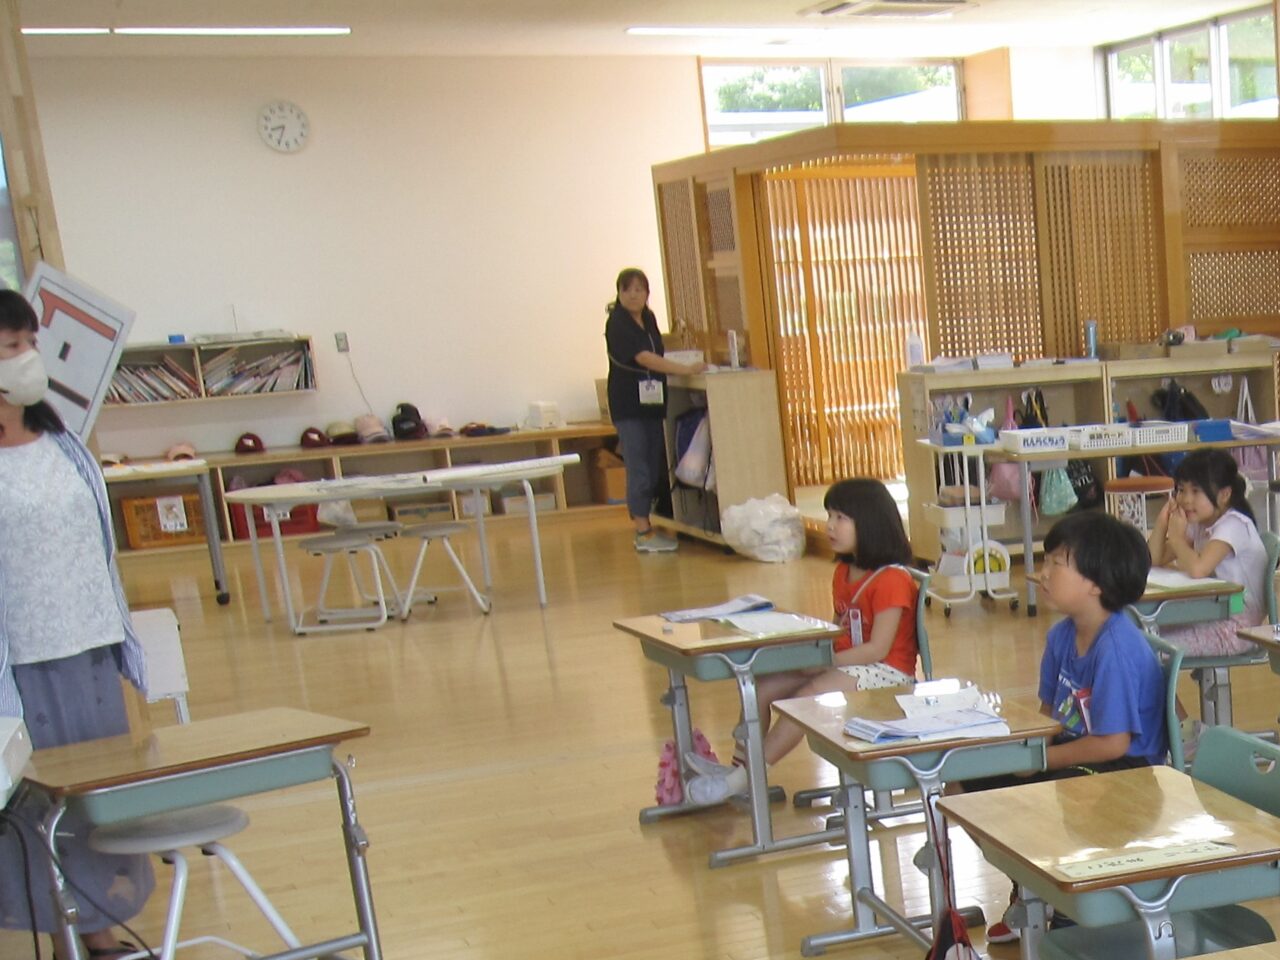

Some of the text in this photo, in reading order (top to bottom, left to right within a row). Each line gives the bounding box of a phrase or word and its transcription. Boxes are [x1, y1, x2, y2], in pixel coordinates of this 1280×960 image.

[1022, 435, 1066, 448] れんらくちょう
